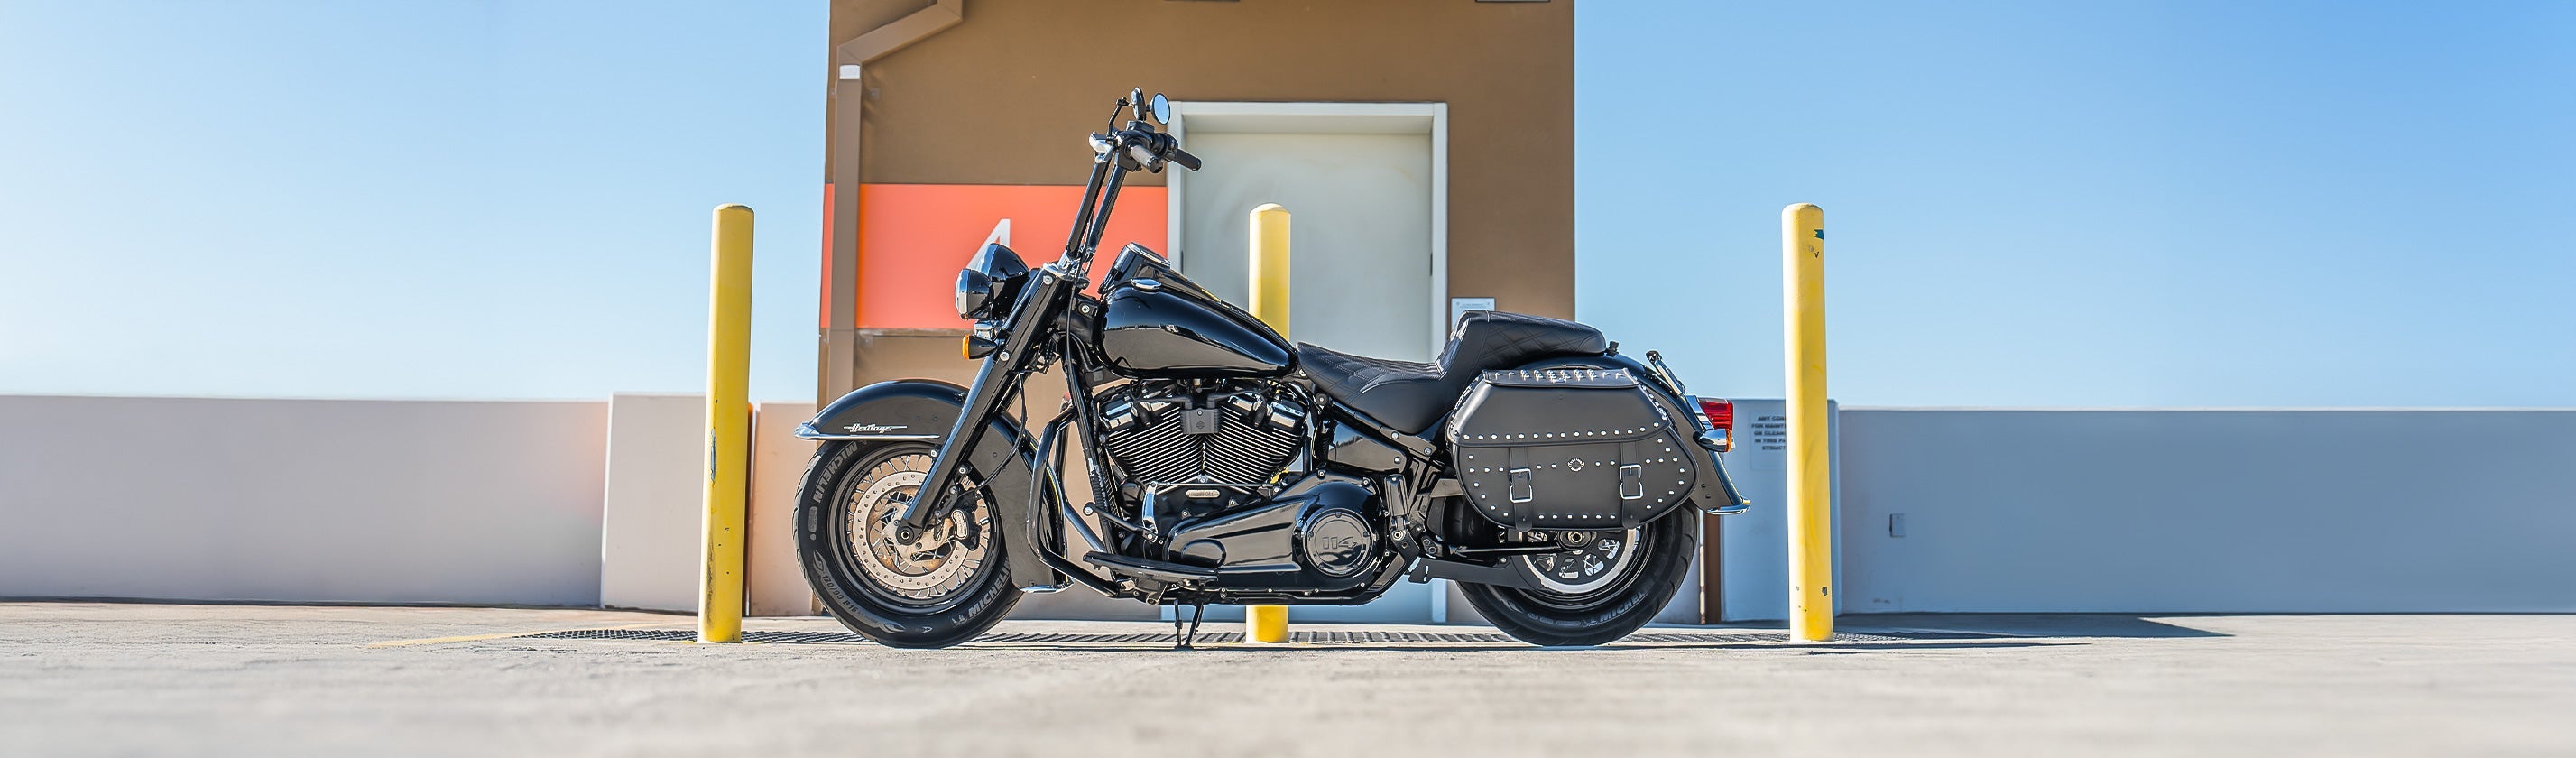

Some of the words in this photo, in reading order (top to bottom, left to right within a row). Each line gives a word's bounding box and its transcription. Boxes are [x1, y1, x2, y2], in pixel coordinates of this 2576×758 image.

[848, 423, 893, 434] Heritage
[813, 441, 858, 504] MICHELIN
[1322, 536, 1358, 550] 114
[822, 575, 845, 601] 130/90
